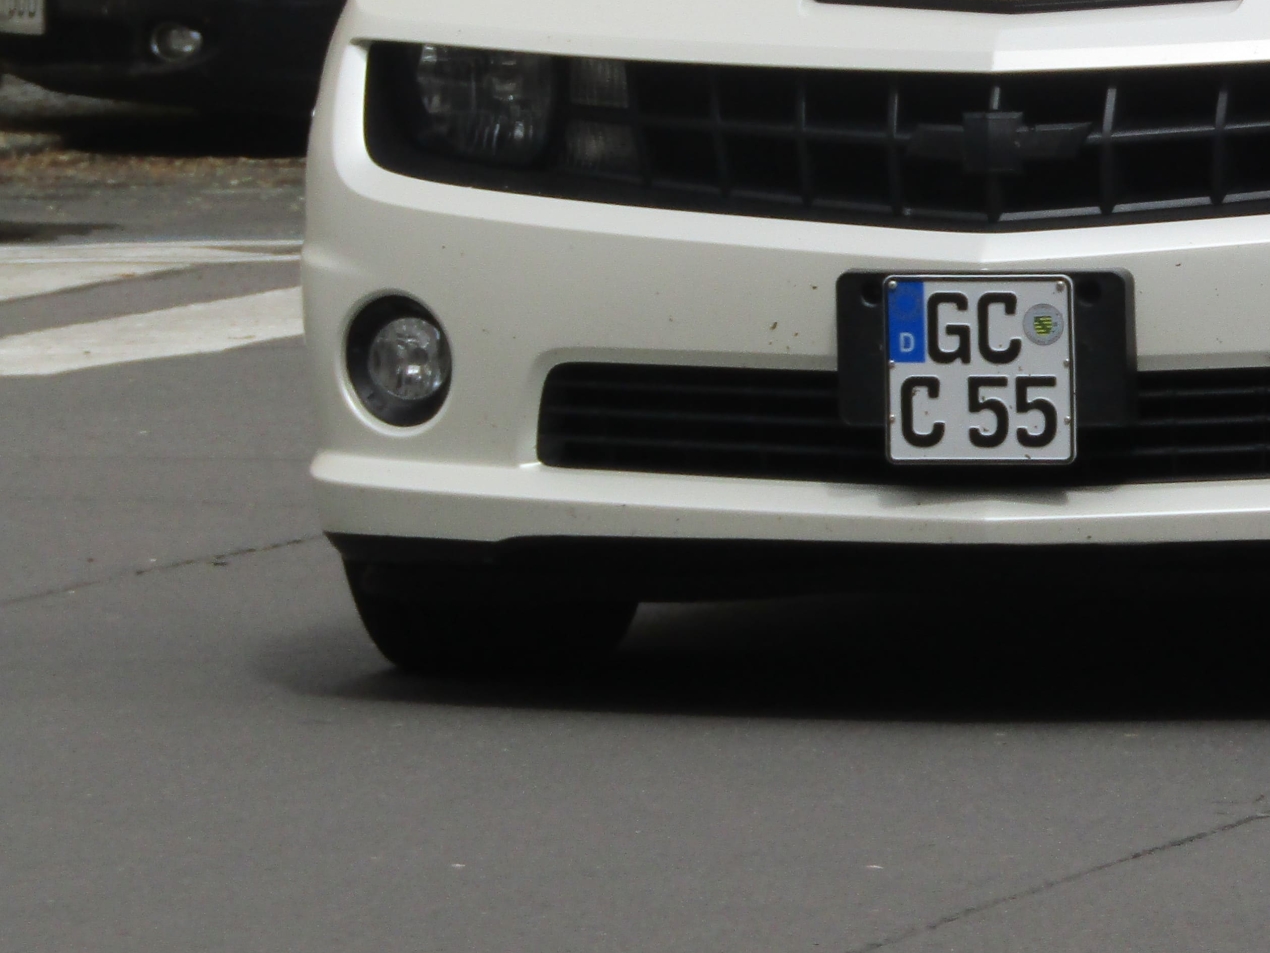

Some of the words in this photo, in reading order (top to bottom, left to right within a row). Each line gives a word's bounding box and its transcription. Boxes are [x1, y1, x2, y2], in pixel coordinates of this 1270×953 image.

[899, 332, 915, 353] D
[926, 292, 1022, 364] GC
[900, 376, 945, 448] C
[967, 376, 1058, 448] 55
